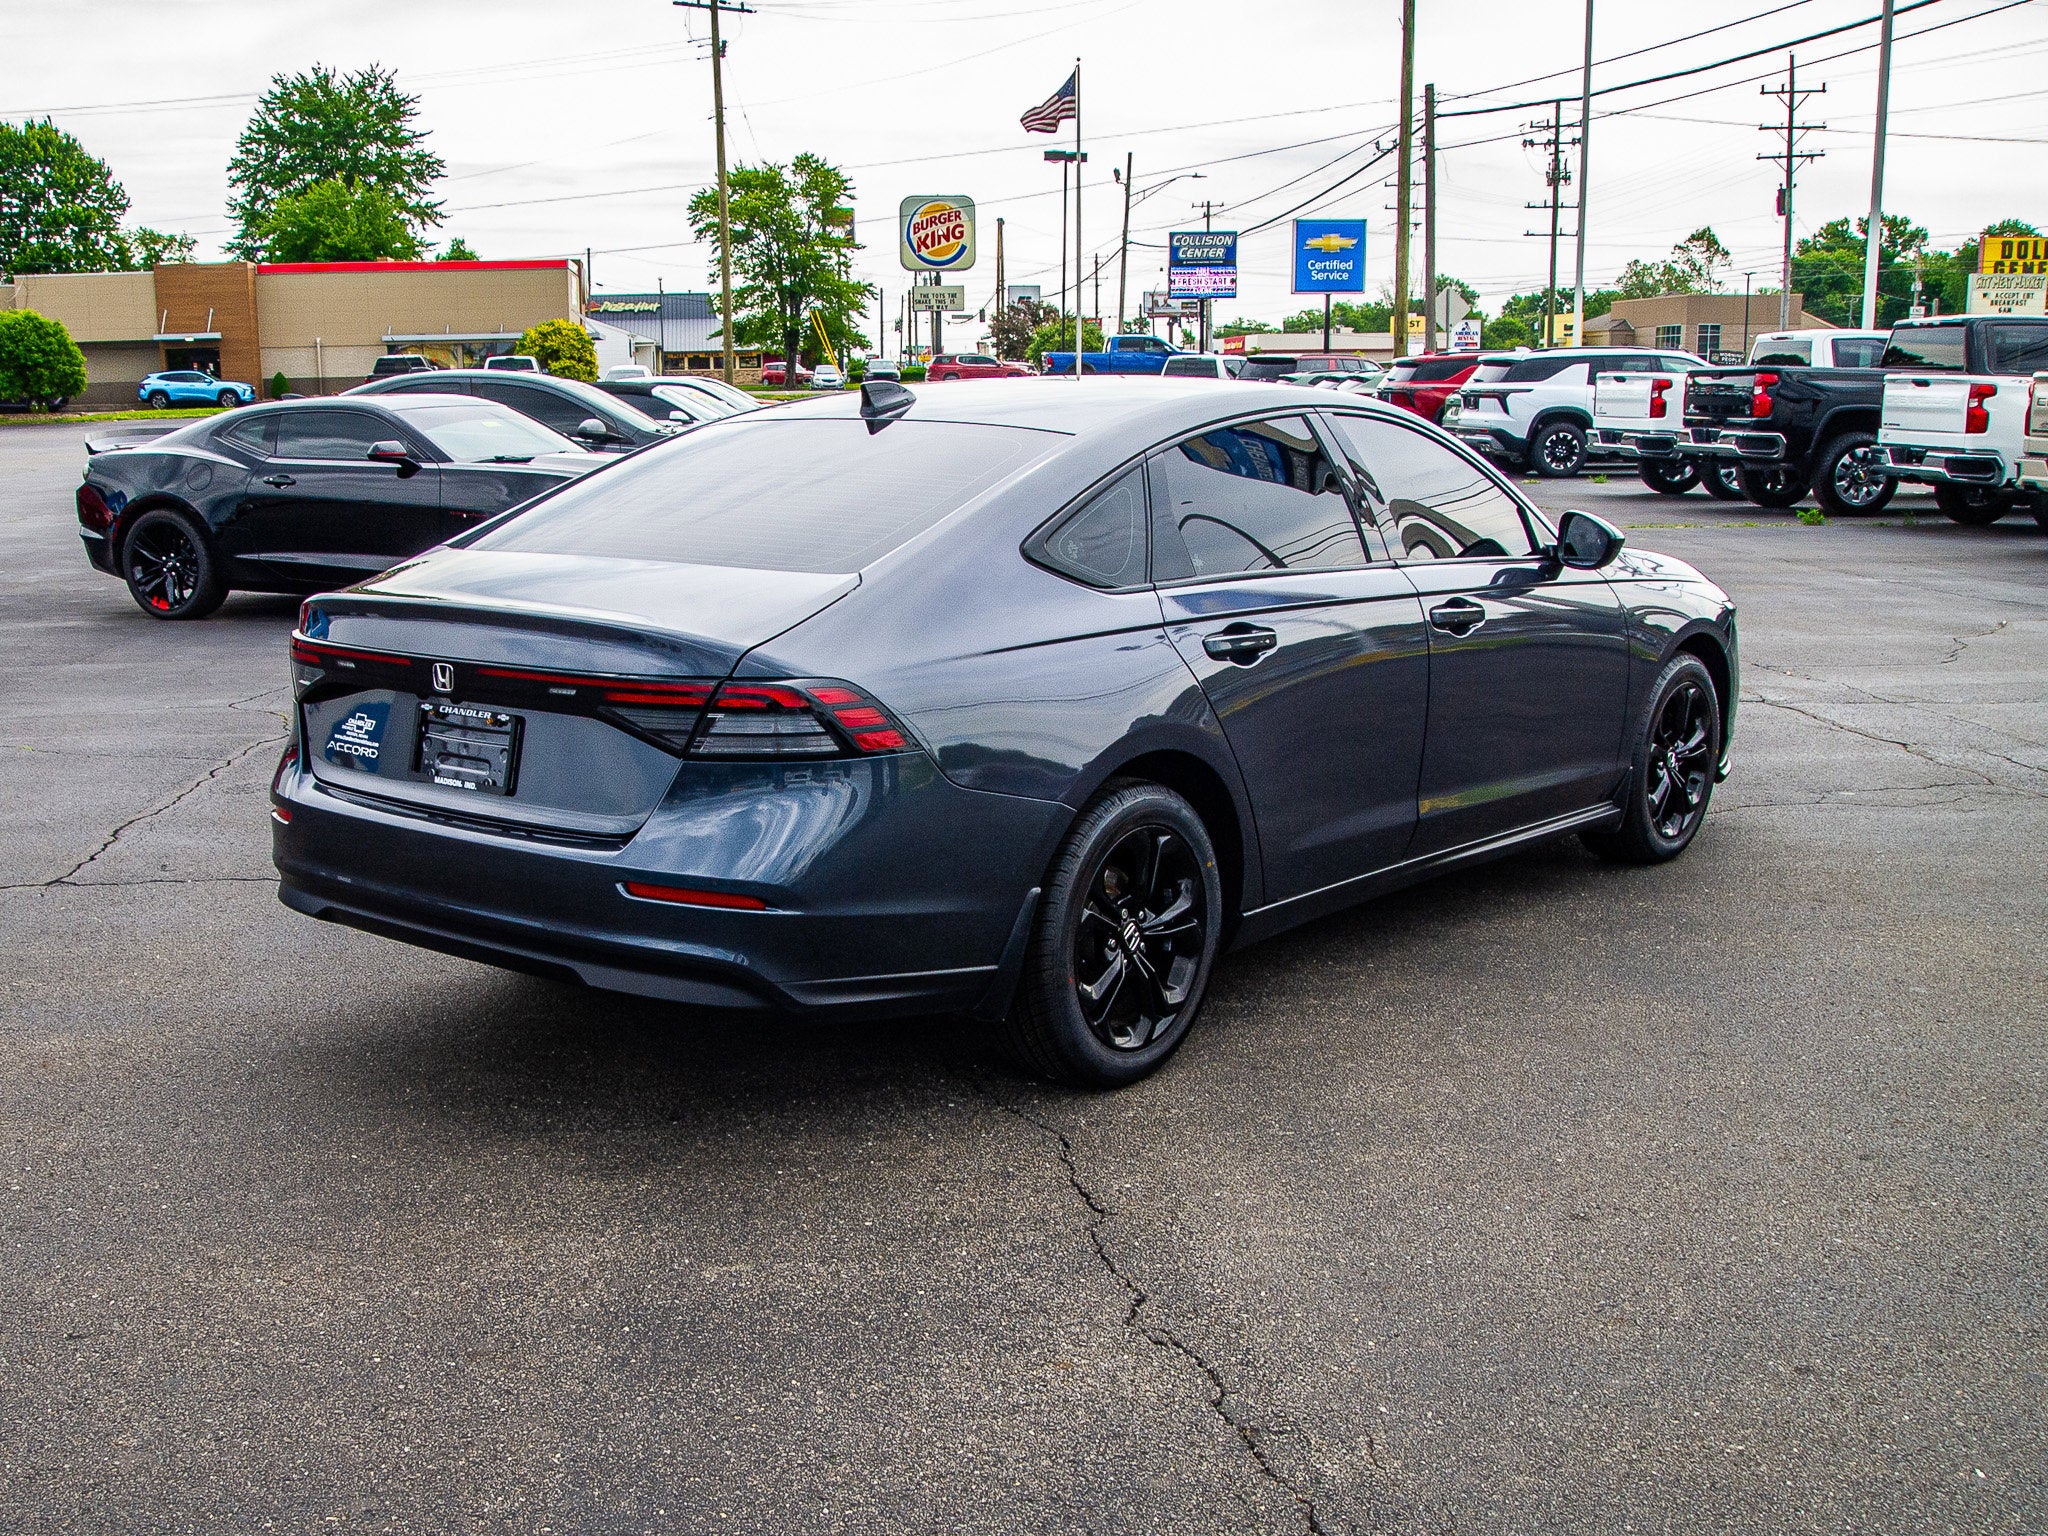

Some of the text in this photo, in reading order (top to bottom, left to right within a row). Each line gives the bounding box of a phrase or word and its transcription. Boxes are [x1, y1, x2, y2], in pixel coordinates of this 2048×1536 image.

[913, 210, 962, 236] BURGER
[916, 223, 965, 253] KING
[1172, 234, 1234, 246] COLLISION
[1178, 247, 1225, 258] CENTER
[1307, 259, 1353, 270] Certified
[1311, 270, 1349, 281] Service
[599, 301, 661, 313] Pizza Hut
[439, 705, 492, 719] CHANDLER
[327, 740, 379, 758] ACCORD
